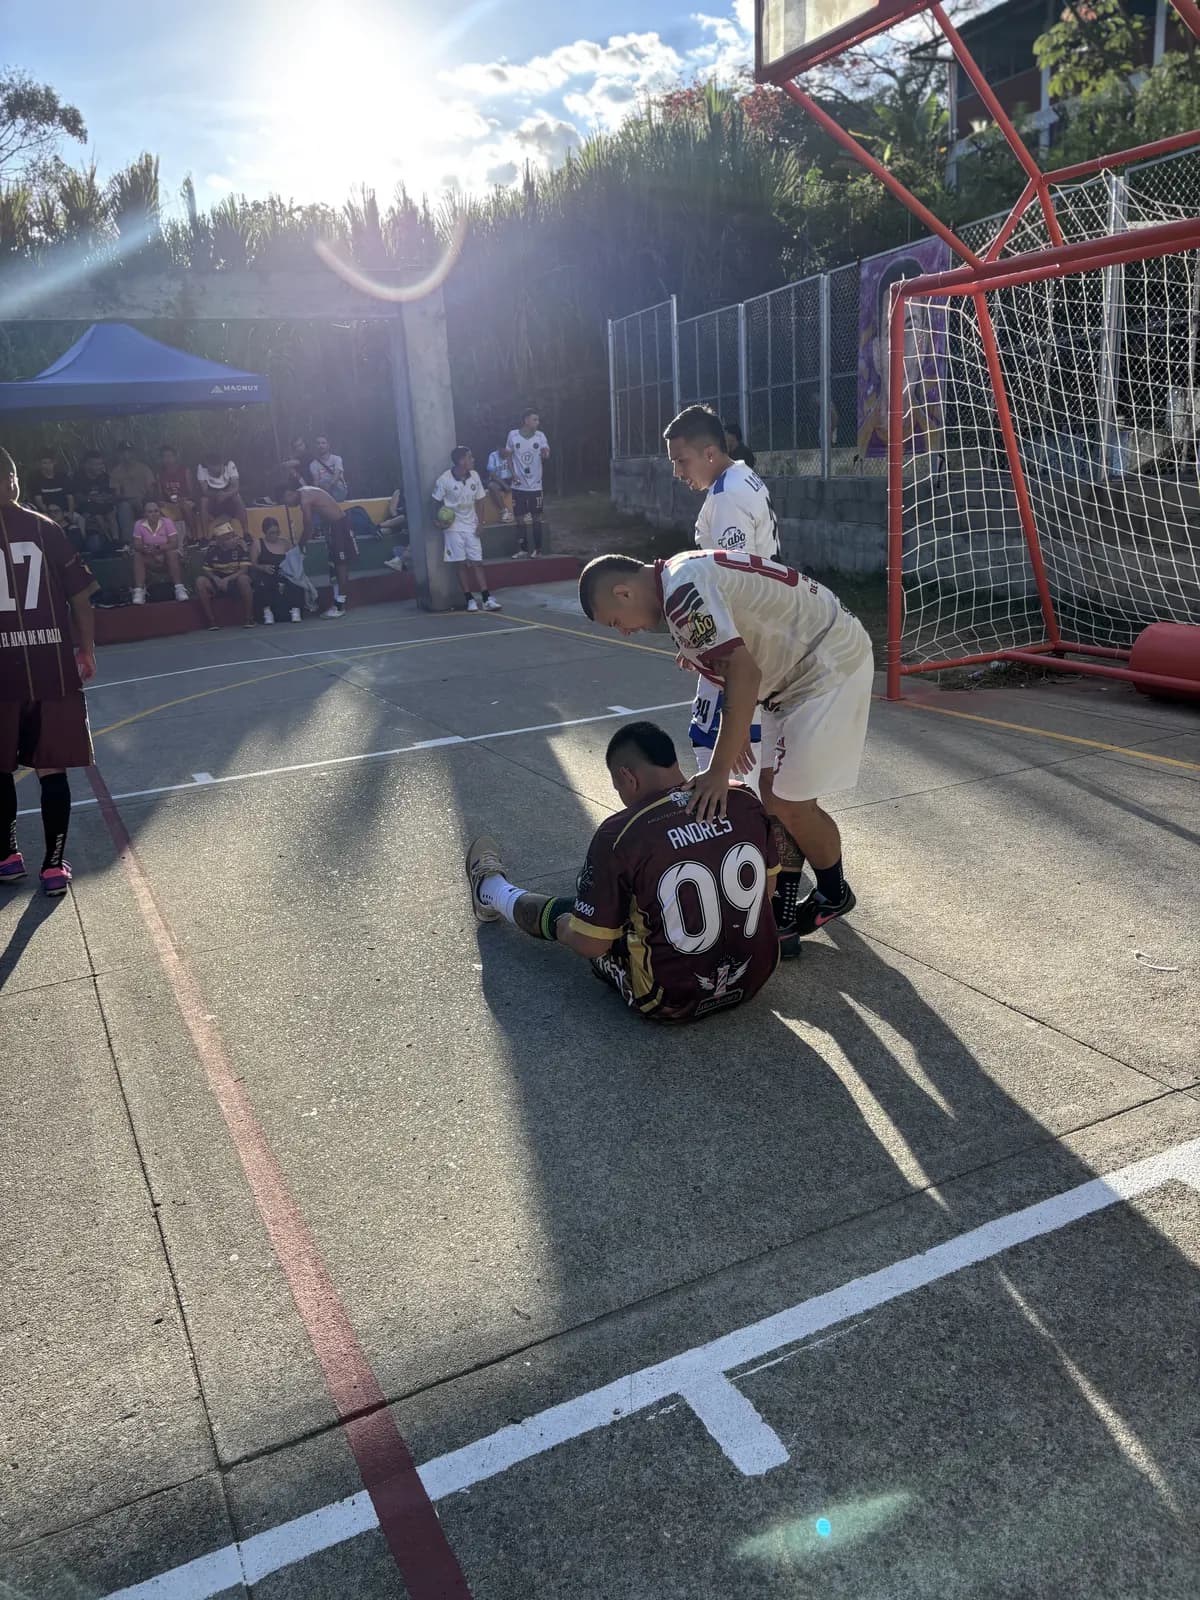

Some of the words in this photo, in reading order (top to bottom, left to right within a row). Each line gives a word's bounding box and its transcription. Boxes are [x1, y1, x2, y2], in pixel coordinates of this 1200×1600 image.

[0, 541, 43, 611] 17
[10, 630, 28, 647] ALMA
[28, 630, 37, 646] DE
[37, 629, 46, 645] MI
[46, 627, 62, 643] RAZA
[667, 815, 733, 849] ANDRES
[657, 841, 766, 954] 09
